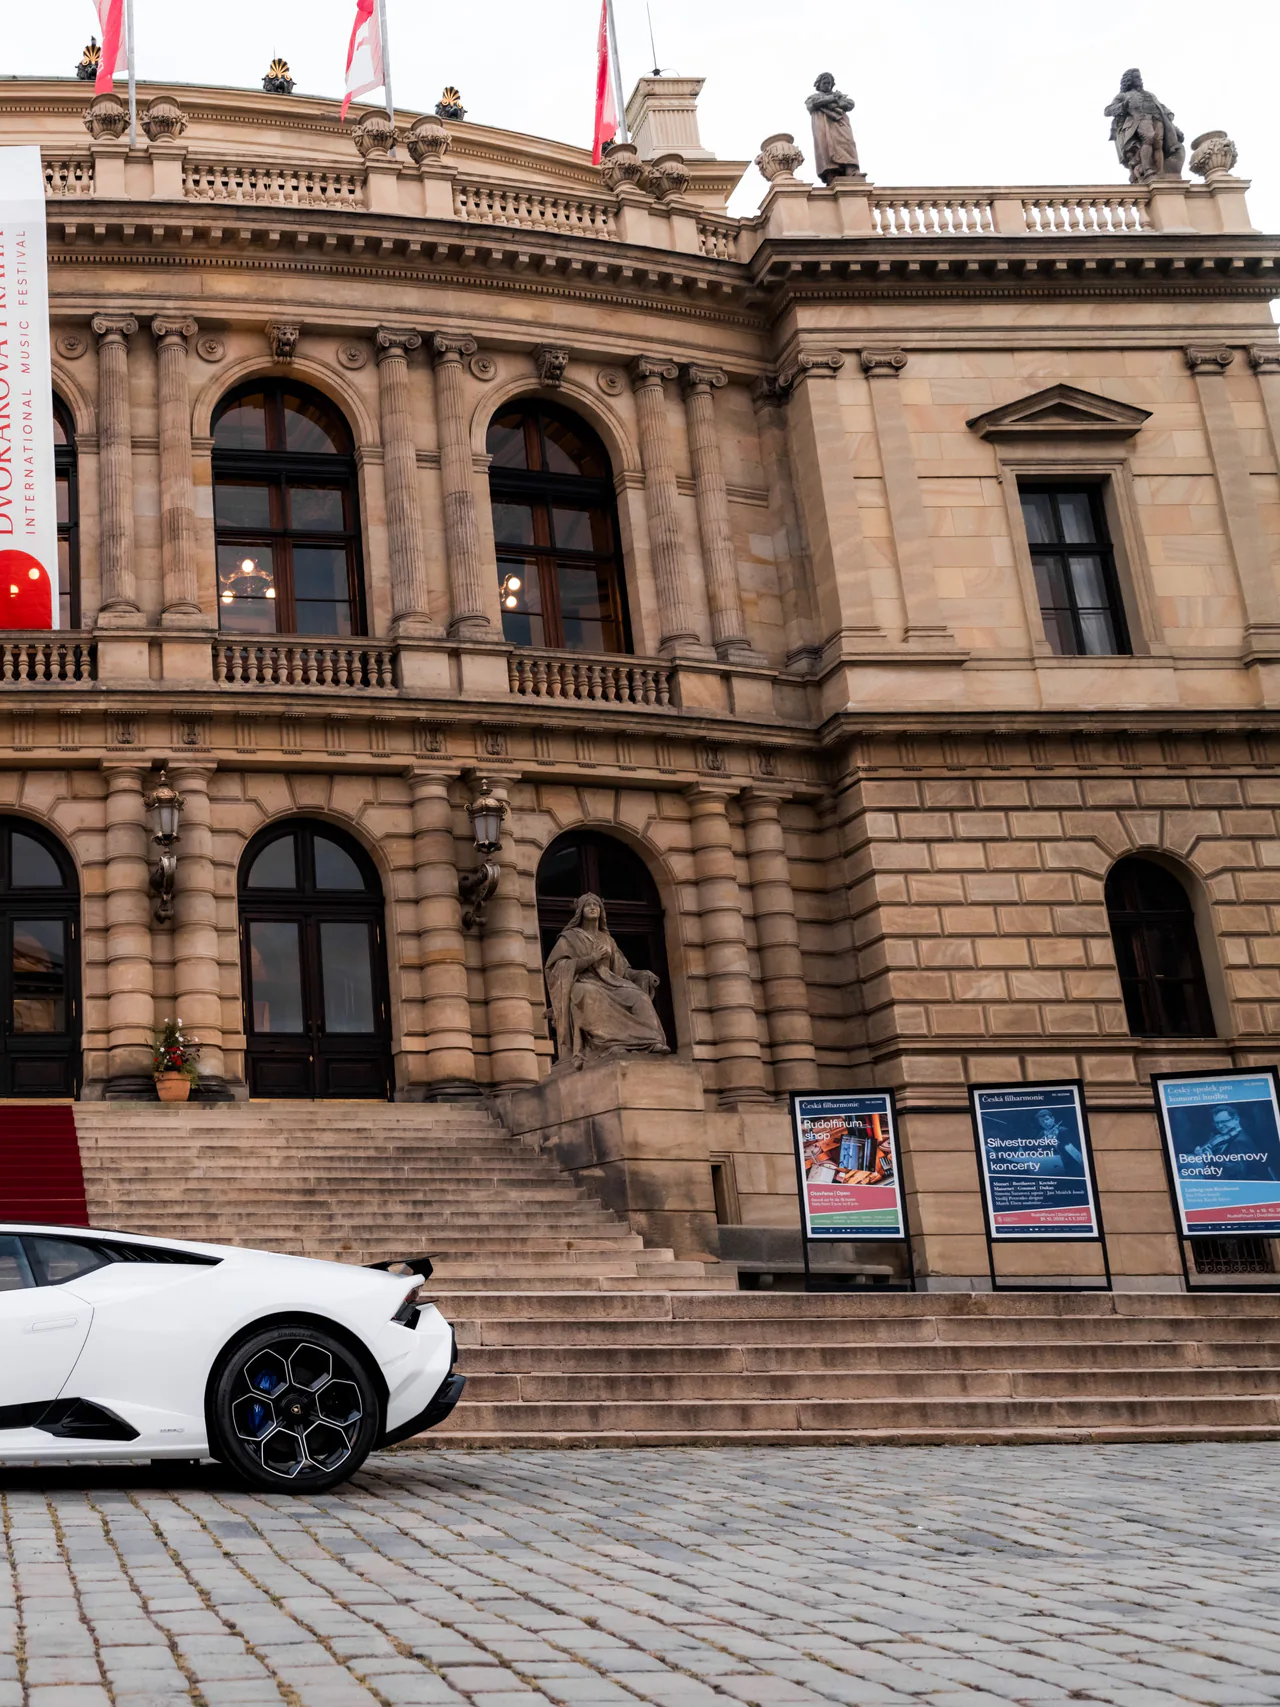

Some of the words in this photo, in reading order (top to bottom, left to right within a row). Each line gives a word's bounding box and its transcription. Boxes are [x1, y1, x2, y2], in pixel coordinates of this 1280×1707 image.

[16, 230, 28, 306] FESTIVAL
[20, 320, 31, 374] MUSIC
[22, 388, 37, 535] INTERNATIONAL
[804, 1120, 862, 1129] Rudolfinum
[805, 1132, 830, 1140] shop
[987, 1136, 1058, 1147] Silvestrovské
[998, 1148, 1054, 1159] novoroční
[1179, 1152, 1268, 1164] Beethovenovy
[990, 1162, 1040, 1171] koncerty
[1181, 1165, 1223, 1177] sonáty
